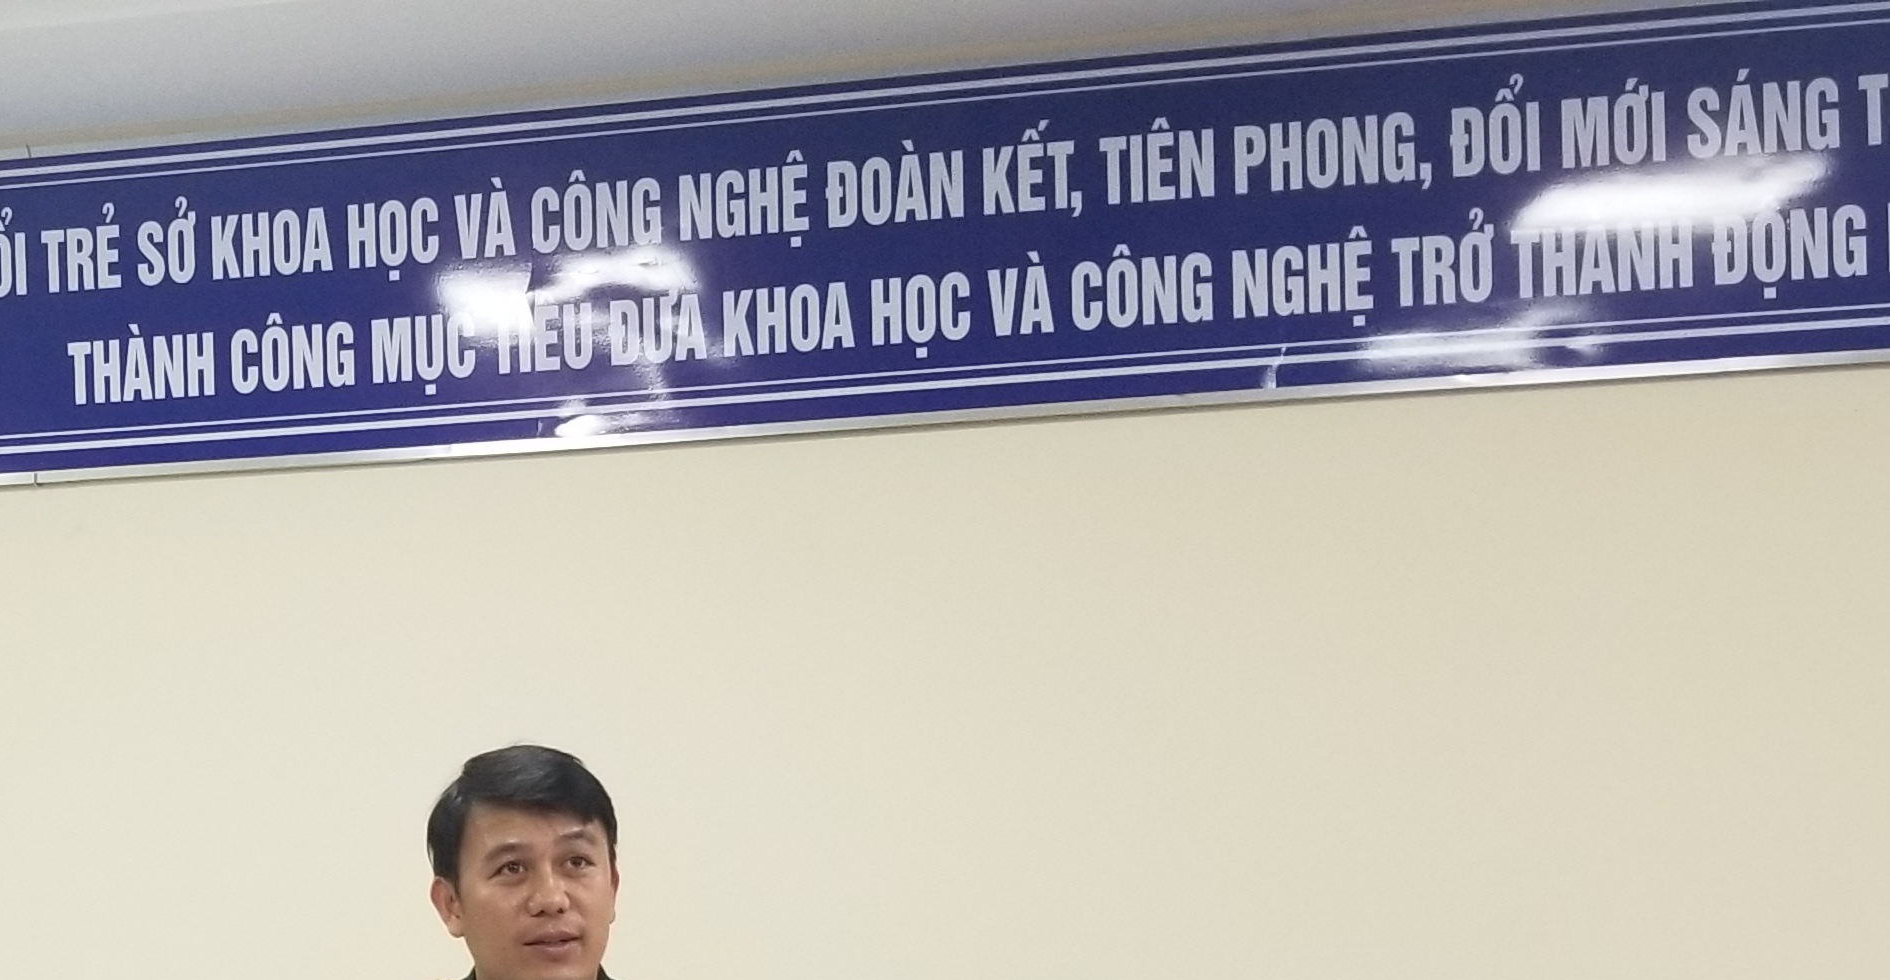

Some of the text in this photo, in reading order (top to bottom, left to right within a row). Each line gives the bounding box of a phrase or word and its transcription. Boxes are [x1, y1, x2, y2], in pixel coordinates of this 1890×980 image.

[41, 203, 121, 293] TRẺ
[138, 197, 195, 286] SỞ
[211, 207, 333, 280] KHOA
[348, 197, 440, 280] HỌC
[454, 177, 516, 259] VÀ
[531, 170, 662, 254] CÔNG
[679, 150, 809, 247] NGHỆ
[826, 140, 964, 228] ĐOÀN
[983, 120, 1082, 217] KẾT,
[1100, 118, 1214, 204] TIÊN
[1234, 112, 1431, 194] PHONG,
[1450, 74, 1540, 177] ĐỔI
[1561, 77, 1666, 168] MỚI
[1687, 69, 1840, 158] SÁNG
[68, 324, 215, 405] THÀNH
[231, 313, 355, 393] CÔNG
[724, 282, 855, 357] KHOA
[871, 272, 970, 358] HỌC
[988, 251, 1054, 336] VÀ
[1072, 244, 1213, 330] CÔNG
[1232, 226, 1373, 326] NGHỆ
[1391, 208, 1494, 307] TRỞ
